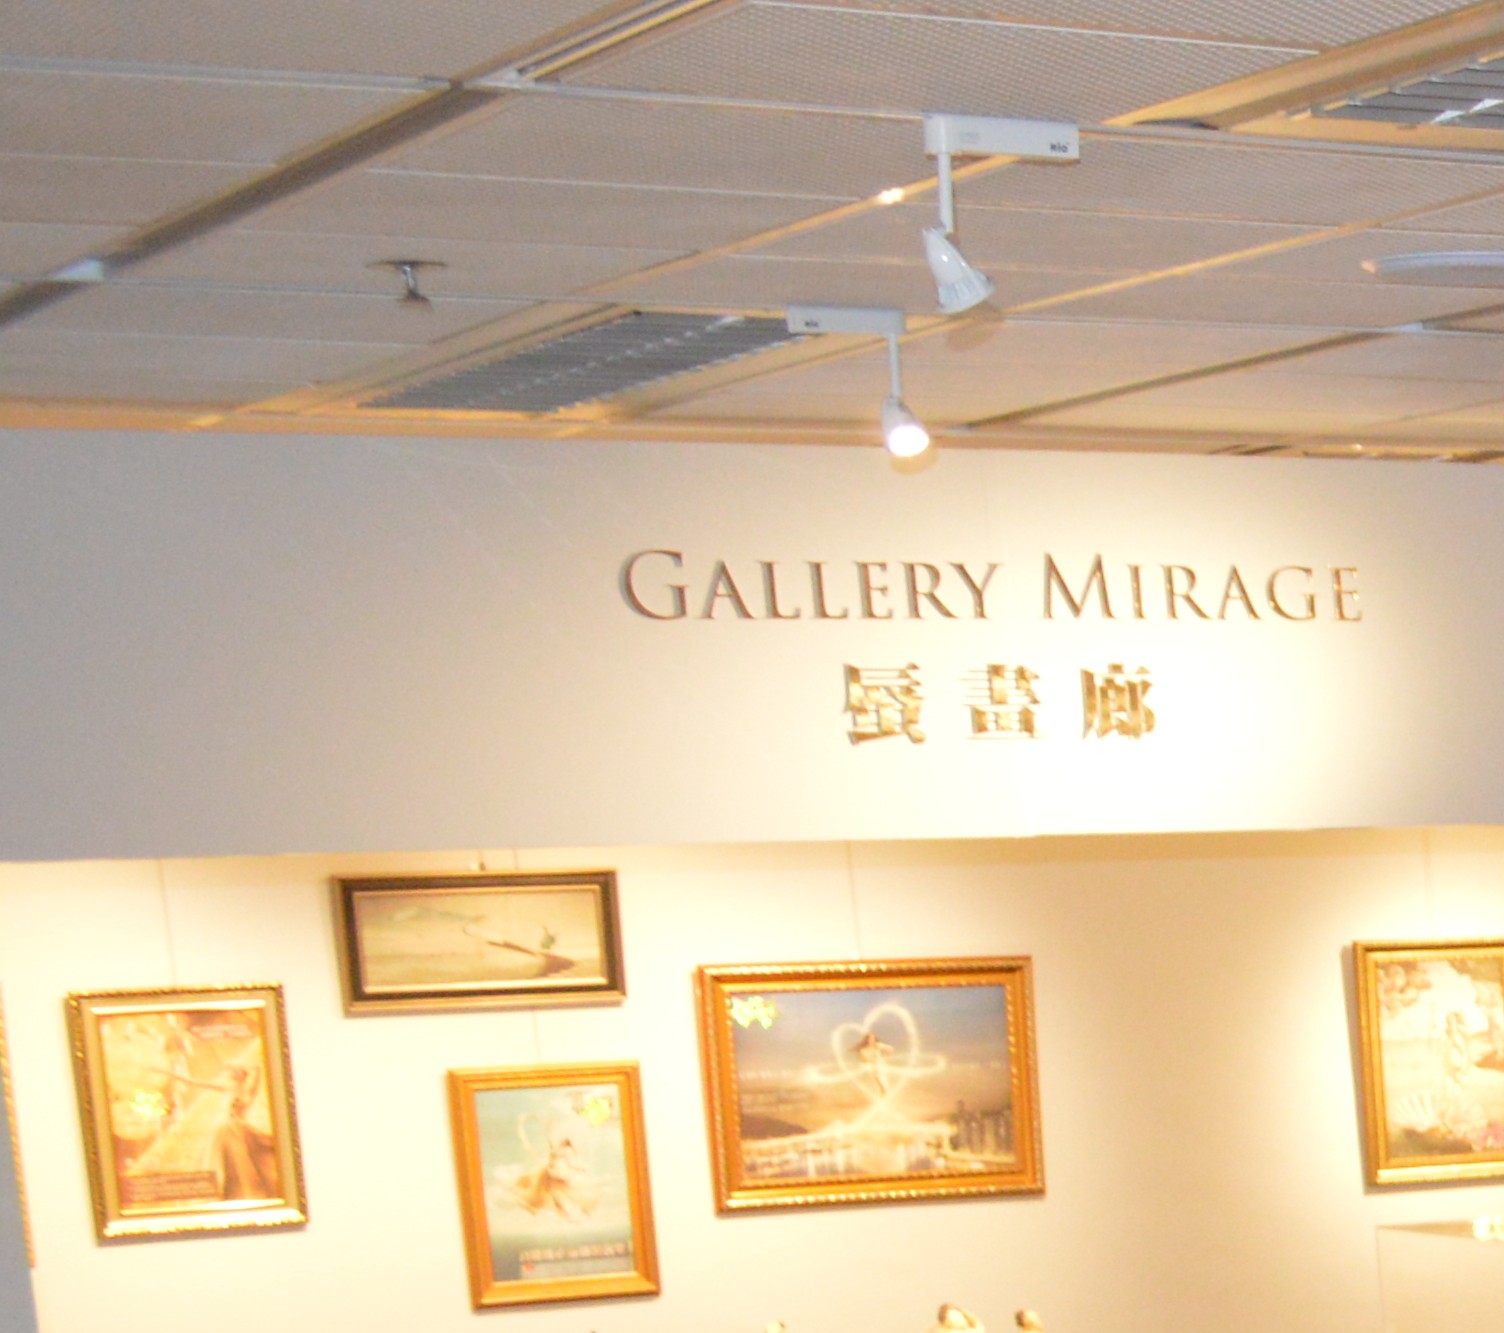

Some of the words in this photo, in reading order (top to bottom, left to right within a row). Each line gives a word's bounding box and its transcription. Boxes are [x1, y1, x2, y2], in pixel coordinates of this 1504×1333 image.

[621, 548, 1001, 622] GALLERY
[1041, 553, 1364, 623] MIRAGE
[843, 661, 1158, 746] 蜃畫廊
